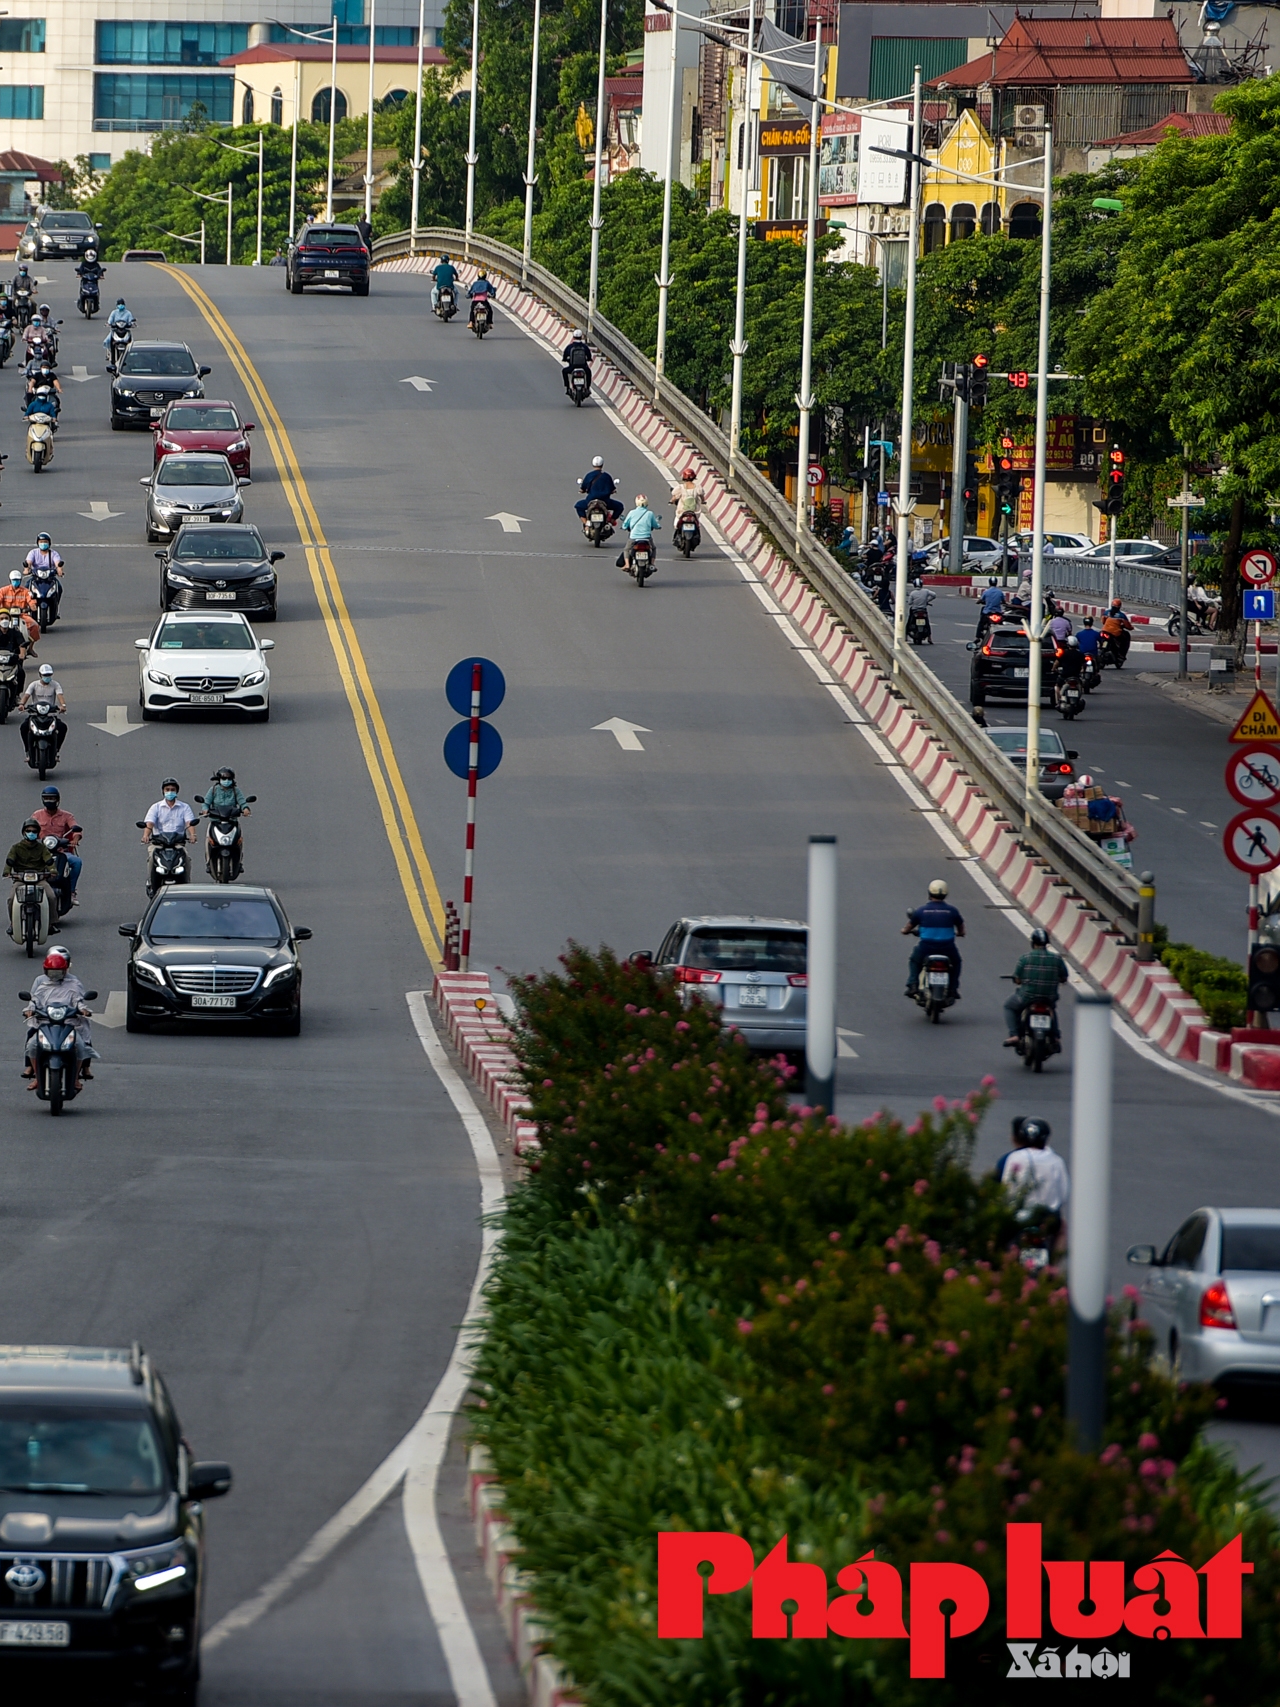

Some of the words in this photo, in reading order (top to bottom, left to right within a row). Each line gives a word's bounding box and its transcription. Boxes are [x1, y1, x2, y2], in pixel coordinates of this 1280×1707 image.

[1008, 372, 1029, 389] 43
[1110, 451, 1124, 463] 43
[1240, 723, 1278, 737] CHẬM
